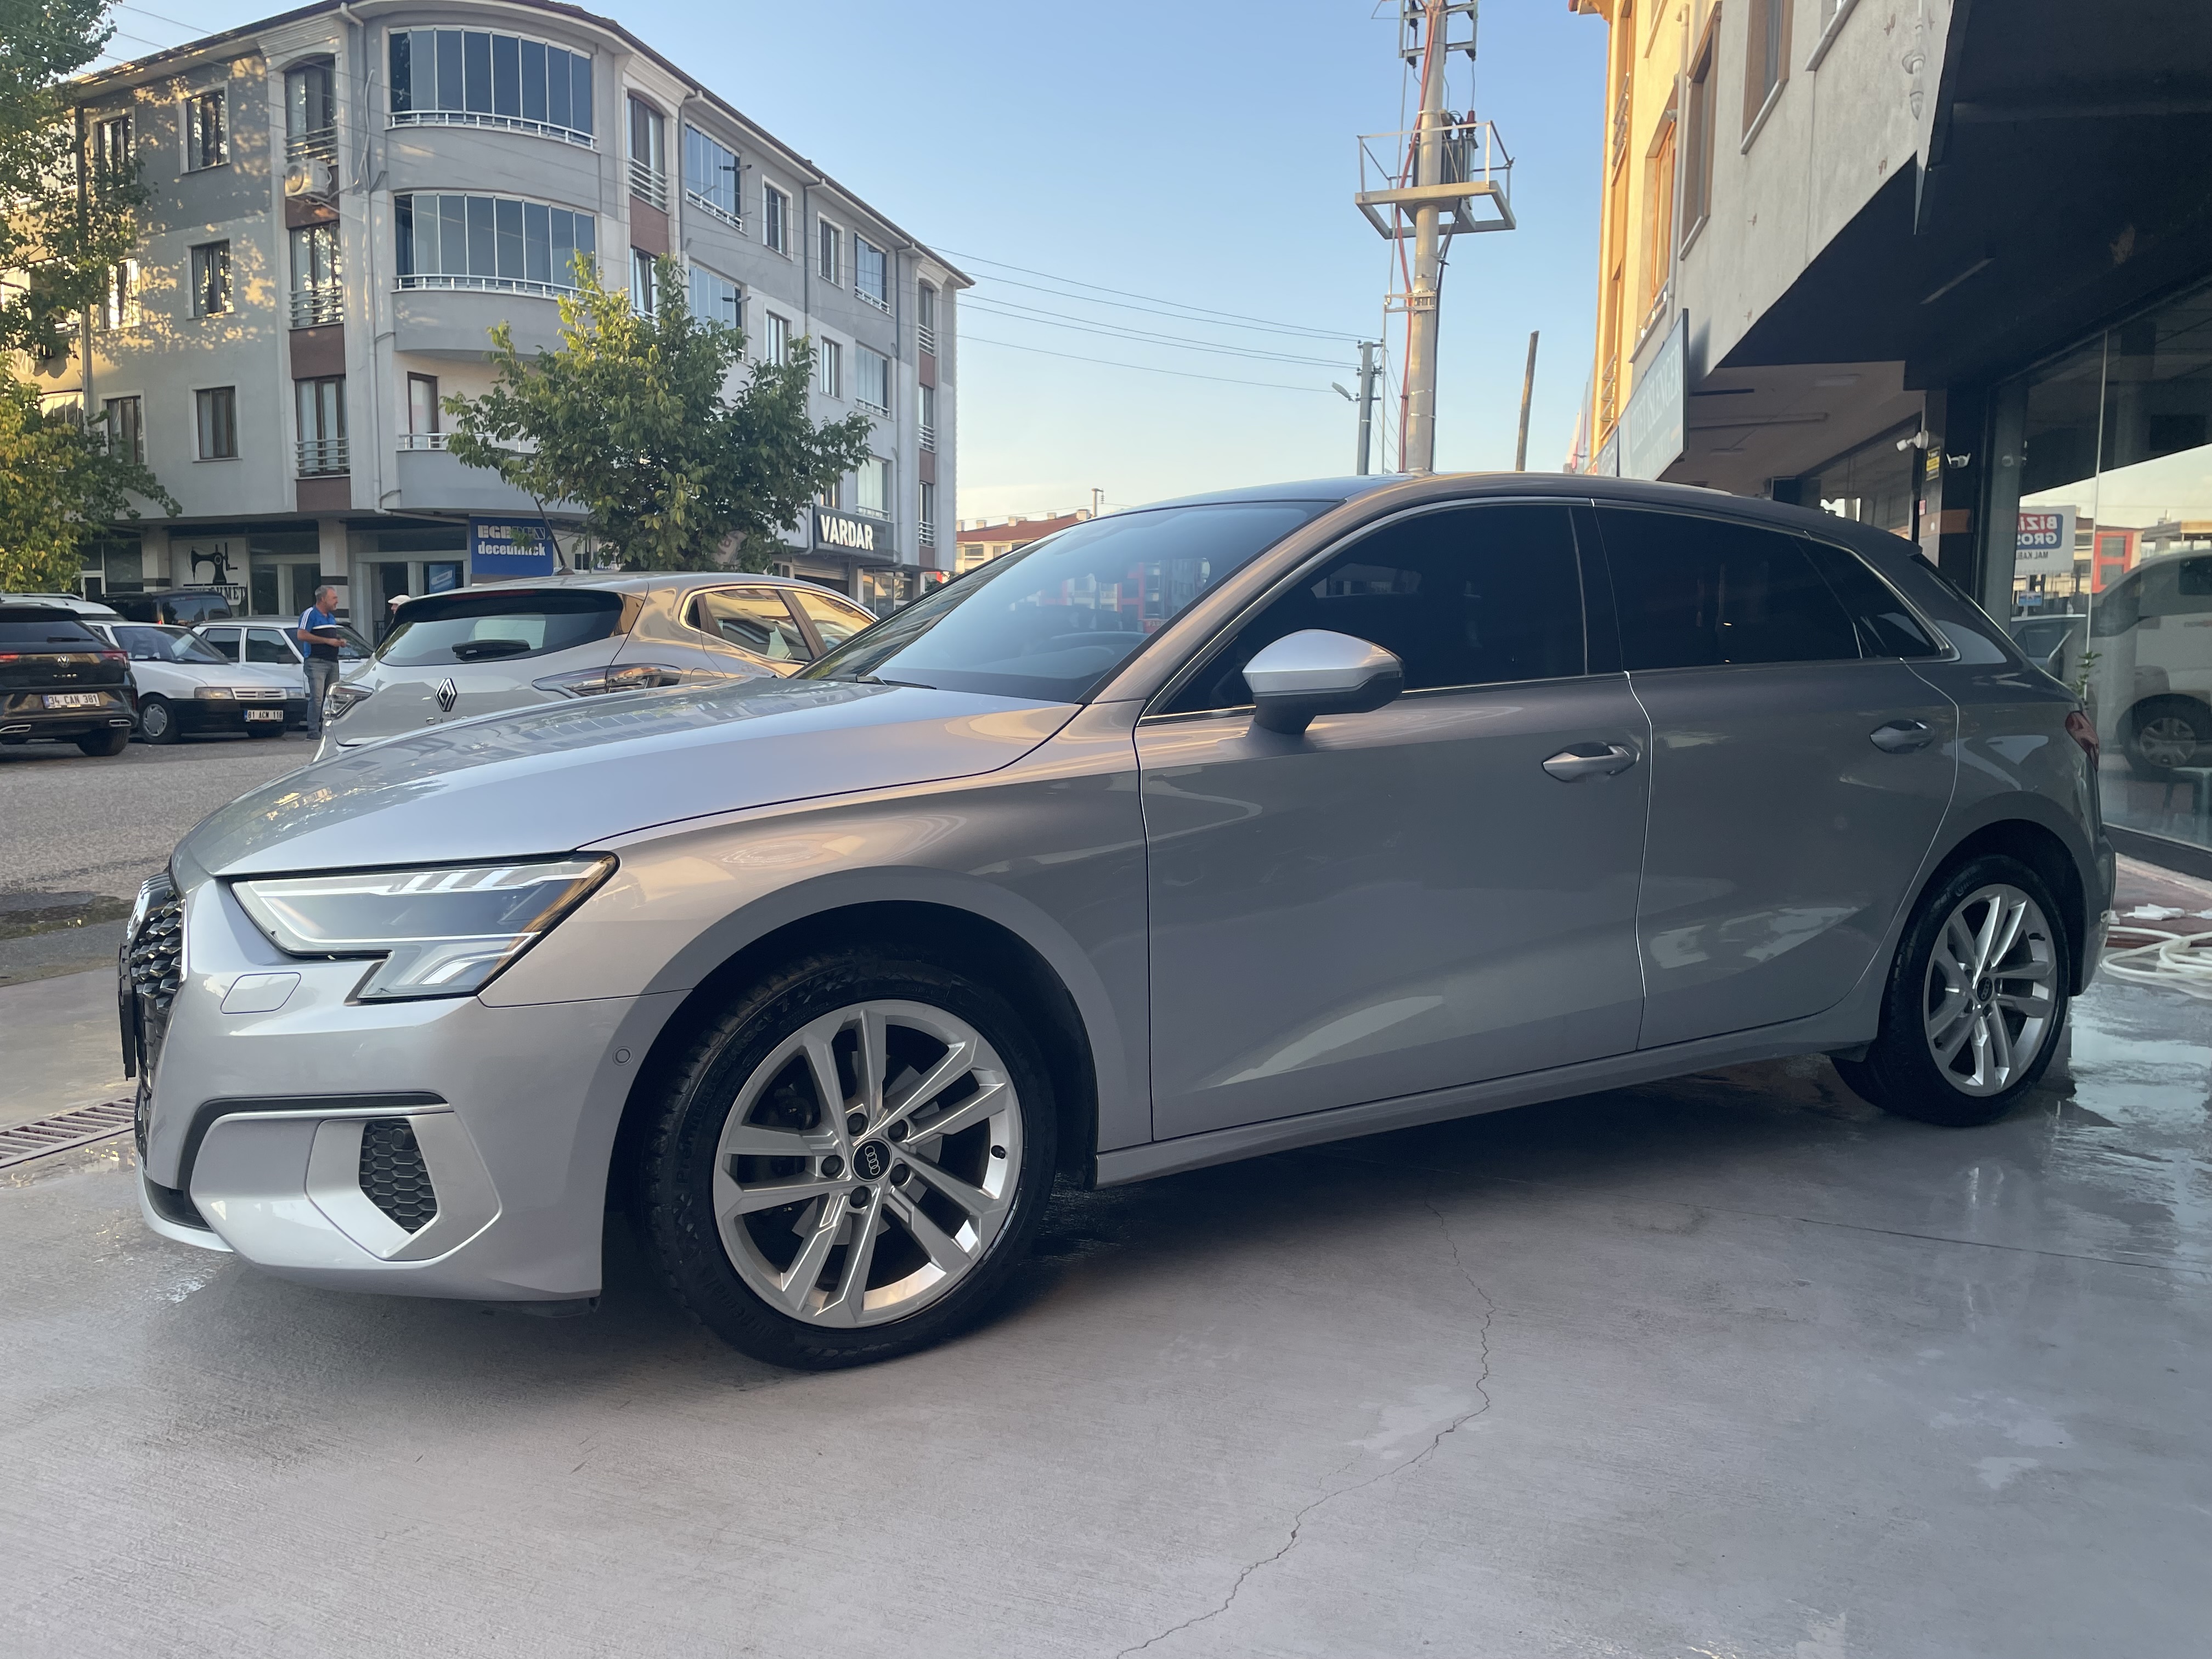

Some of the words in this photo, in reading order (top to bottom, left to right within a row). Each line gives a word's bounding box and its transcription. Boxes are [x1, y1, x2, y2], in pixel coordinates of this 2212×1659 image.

[820, 514, 874, 551] VARDAR
[49, 696, 60, 705] 34
[64, 695, 80, 704] CAN
[83, 694, 98, 703] 381
